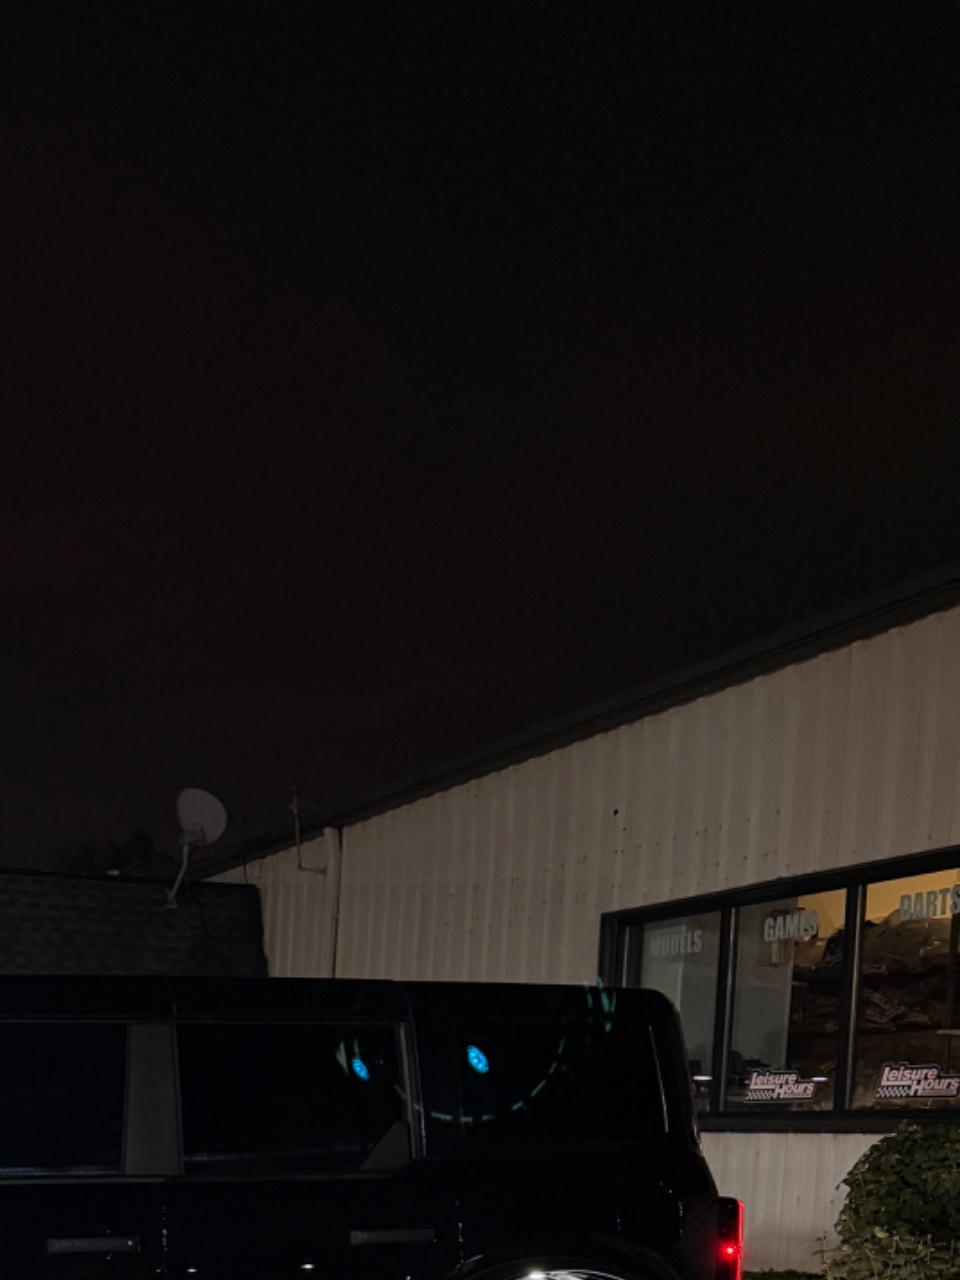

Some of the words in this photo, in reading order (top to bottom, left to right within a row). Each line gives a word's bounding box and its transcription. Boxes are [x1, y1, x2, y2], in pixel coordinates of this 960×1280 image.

[899, 884, 960, 921] DARTS
[764, 910, 818, 943] GAMES
[649, 928, 703, 958] MODELS
[750, 1071, 797, 1090] Leisure
[880, 1066, 938, 1086] Leisure
[773, 1083, 814, 1099] Hours
[909, 1078, 959, 1096] Hours
